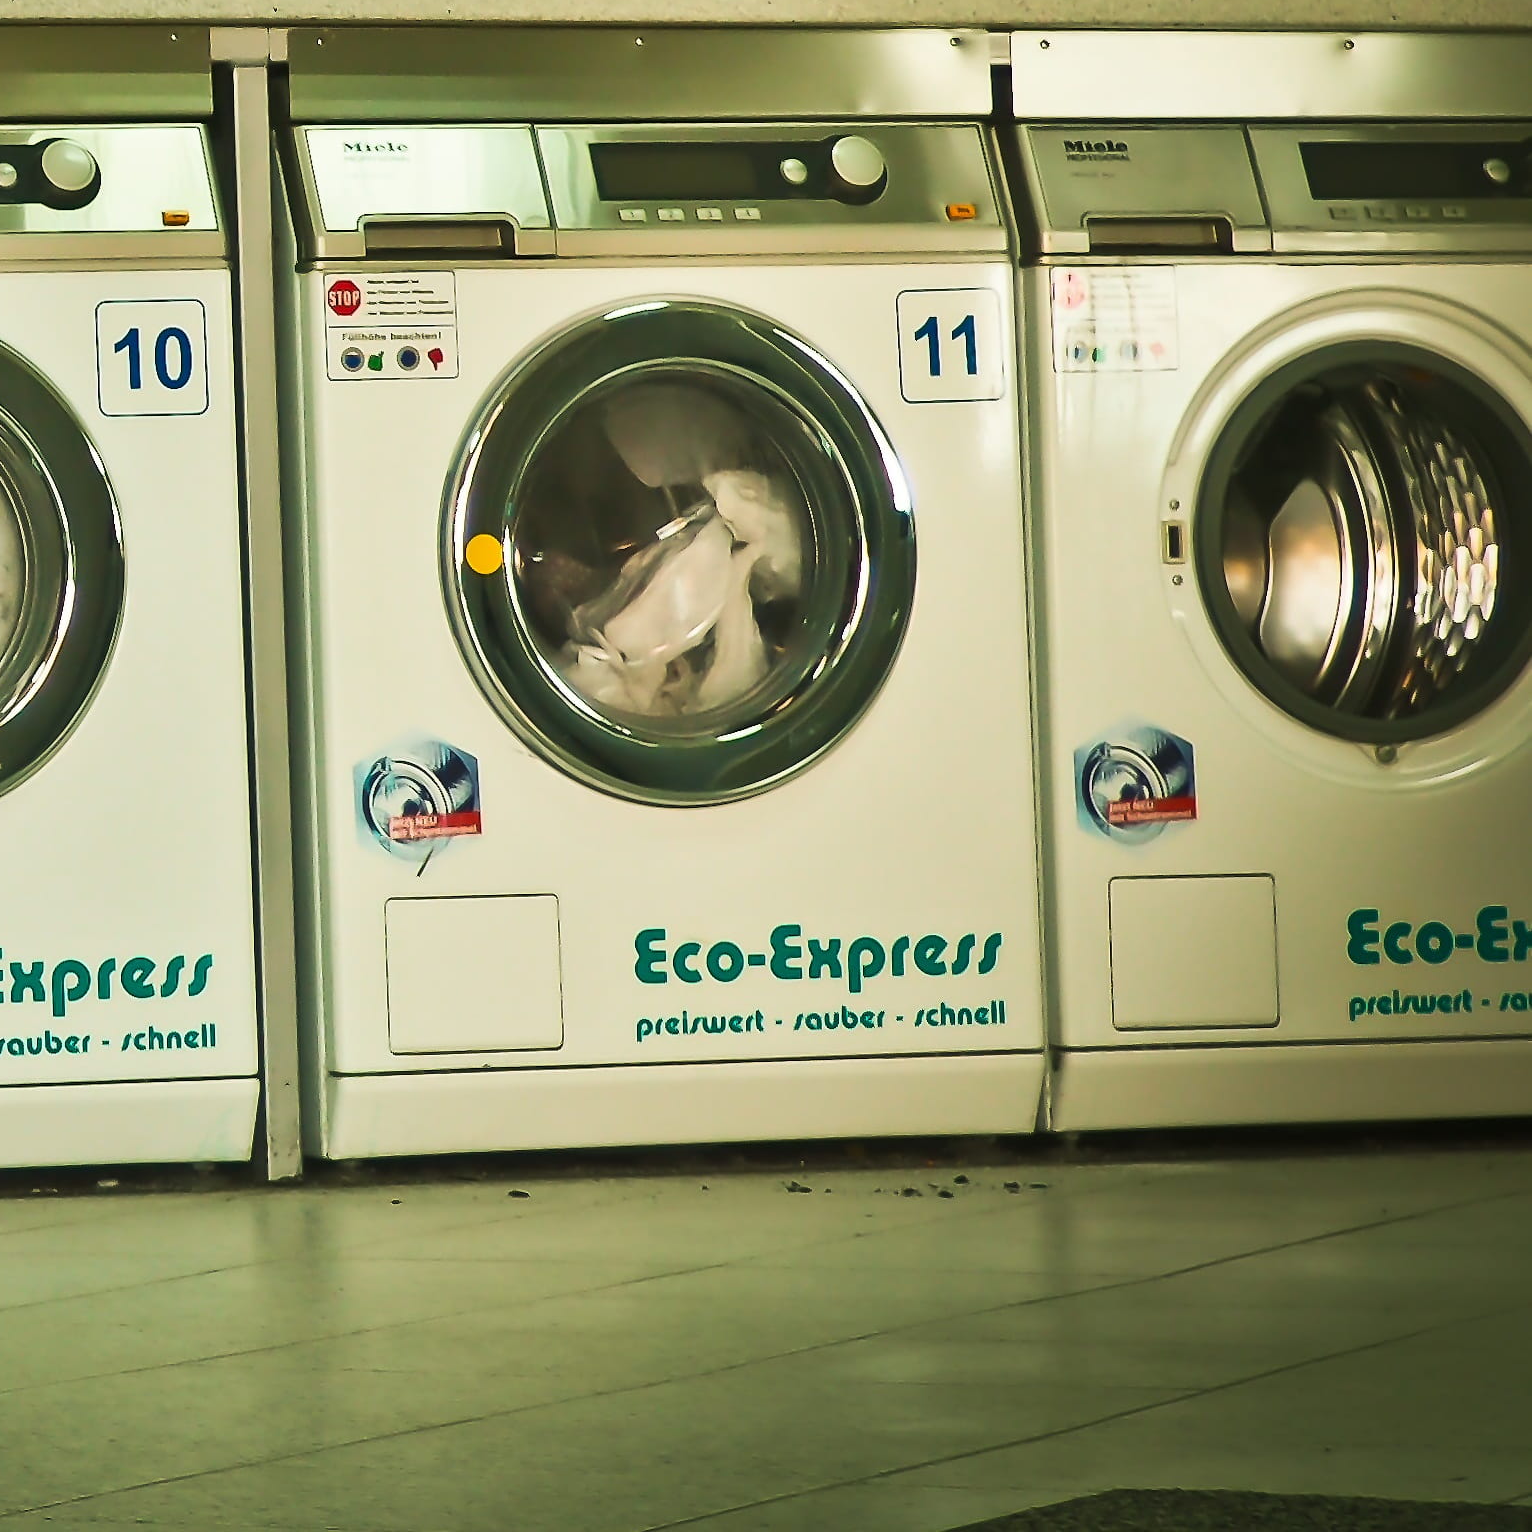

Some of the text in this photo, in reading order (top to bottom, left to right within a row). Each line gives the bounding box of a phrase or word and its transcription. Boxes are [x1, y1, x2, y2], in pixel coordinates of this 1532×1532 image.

[343, 142, 409, 152] Miele
[1064, 139, 1129, 153] Miele
[328, 290, 361, 307] STOP
[113, 326, 193, 390] 10
[913, 314, 978, 377] 11
[634, 924, 1004, 995] Eco-Express
[636, 1009, 765, 1043] preiswert
[793, 1006, 886, 1031] sauber
[914, 1000, 1007, 1026] schnell
[1349, 990, 1471, 1022] preiswert
[121, 1023, 217, 1051] schnell
